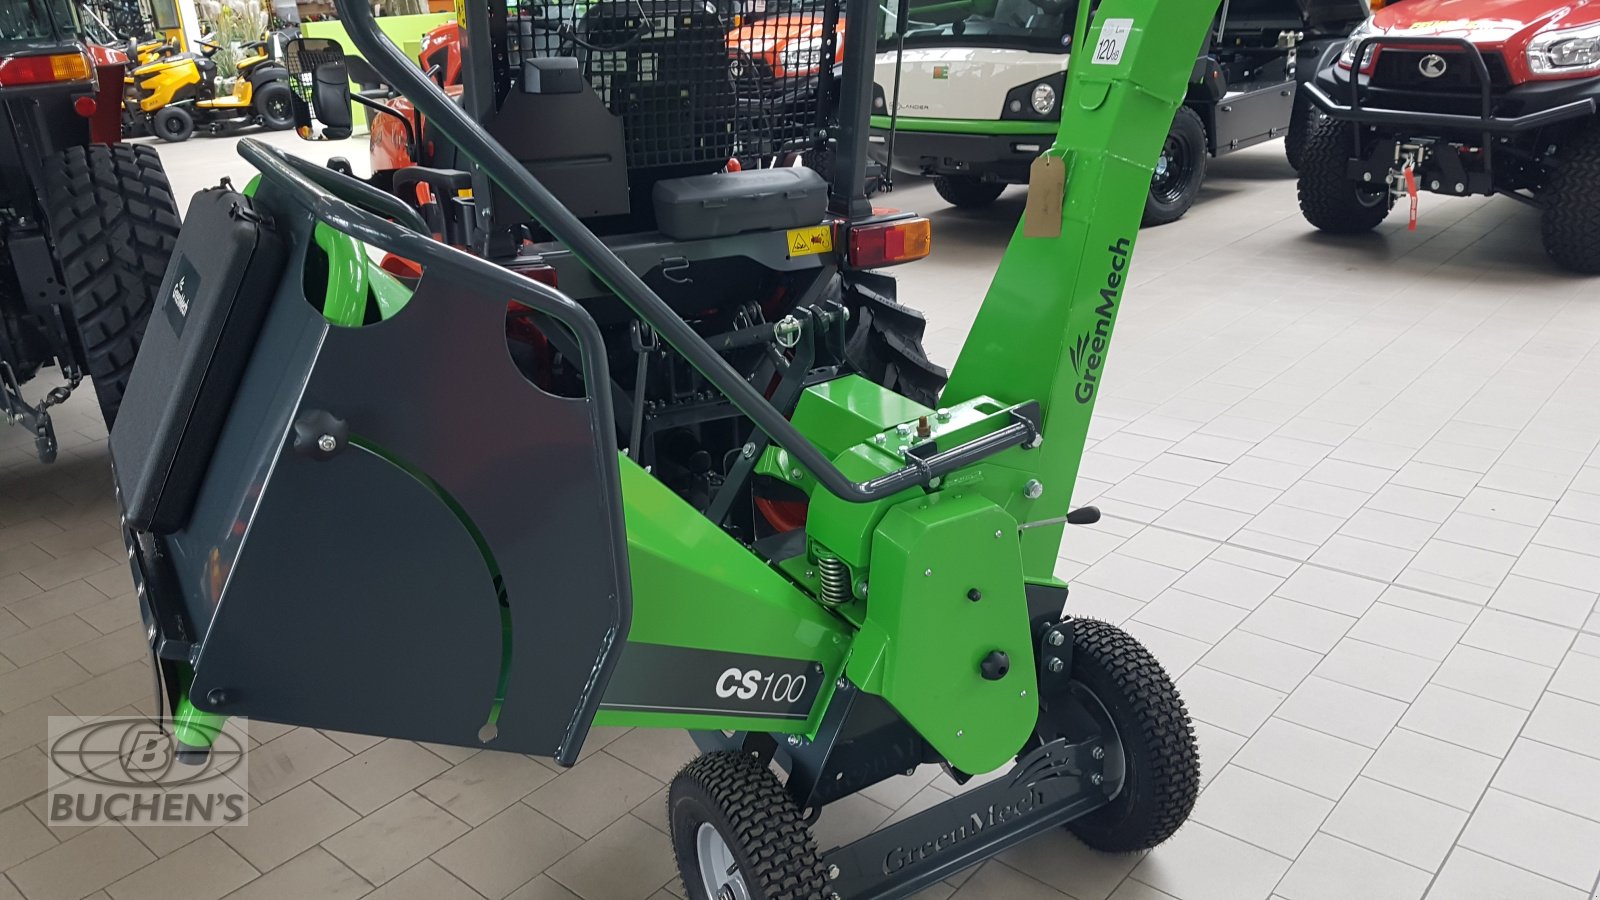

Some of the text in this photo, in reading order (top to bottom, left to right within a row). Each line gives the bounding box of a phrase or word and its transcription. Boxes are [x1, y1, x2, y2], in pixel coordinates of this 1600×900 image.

[1075, 236, 1131, 405] GreenMech
[715, 667, 807, 703] CS100
[882, 782, 1044, 876] GreenMech
